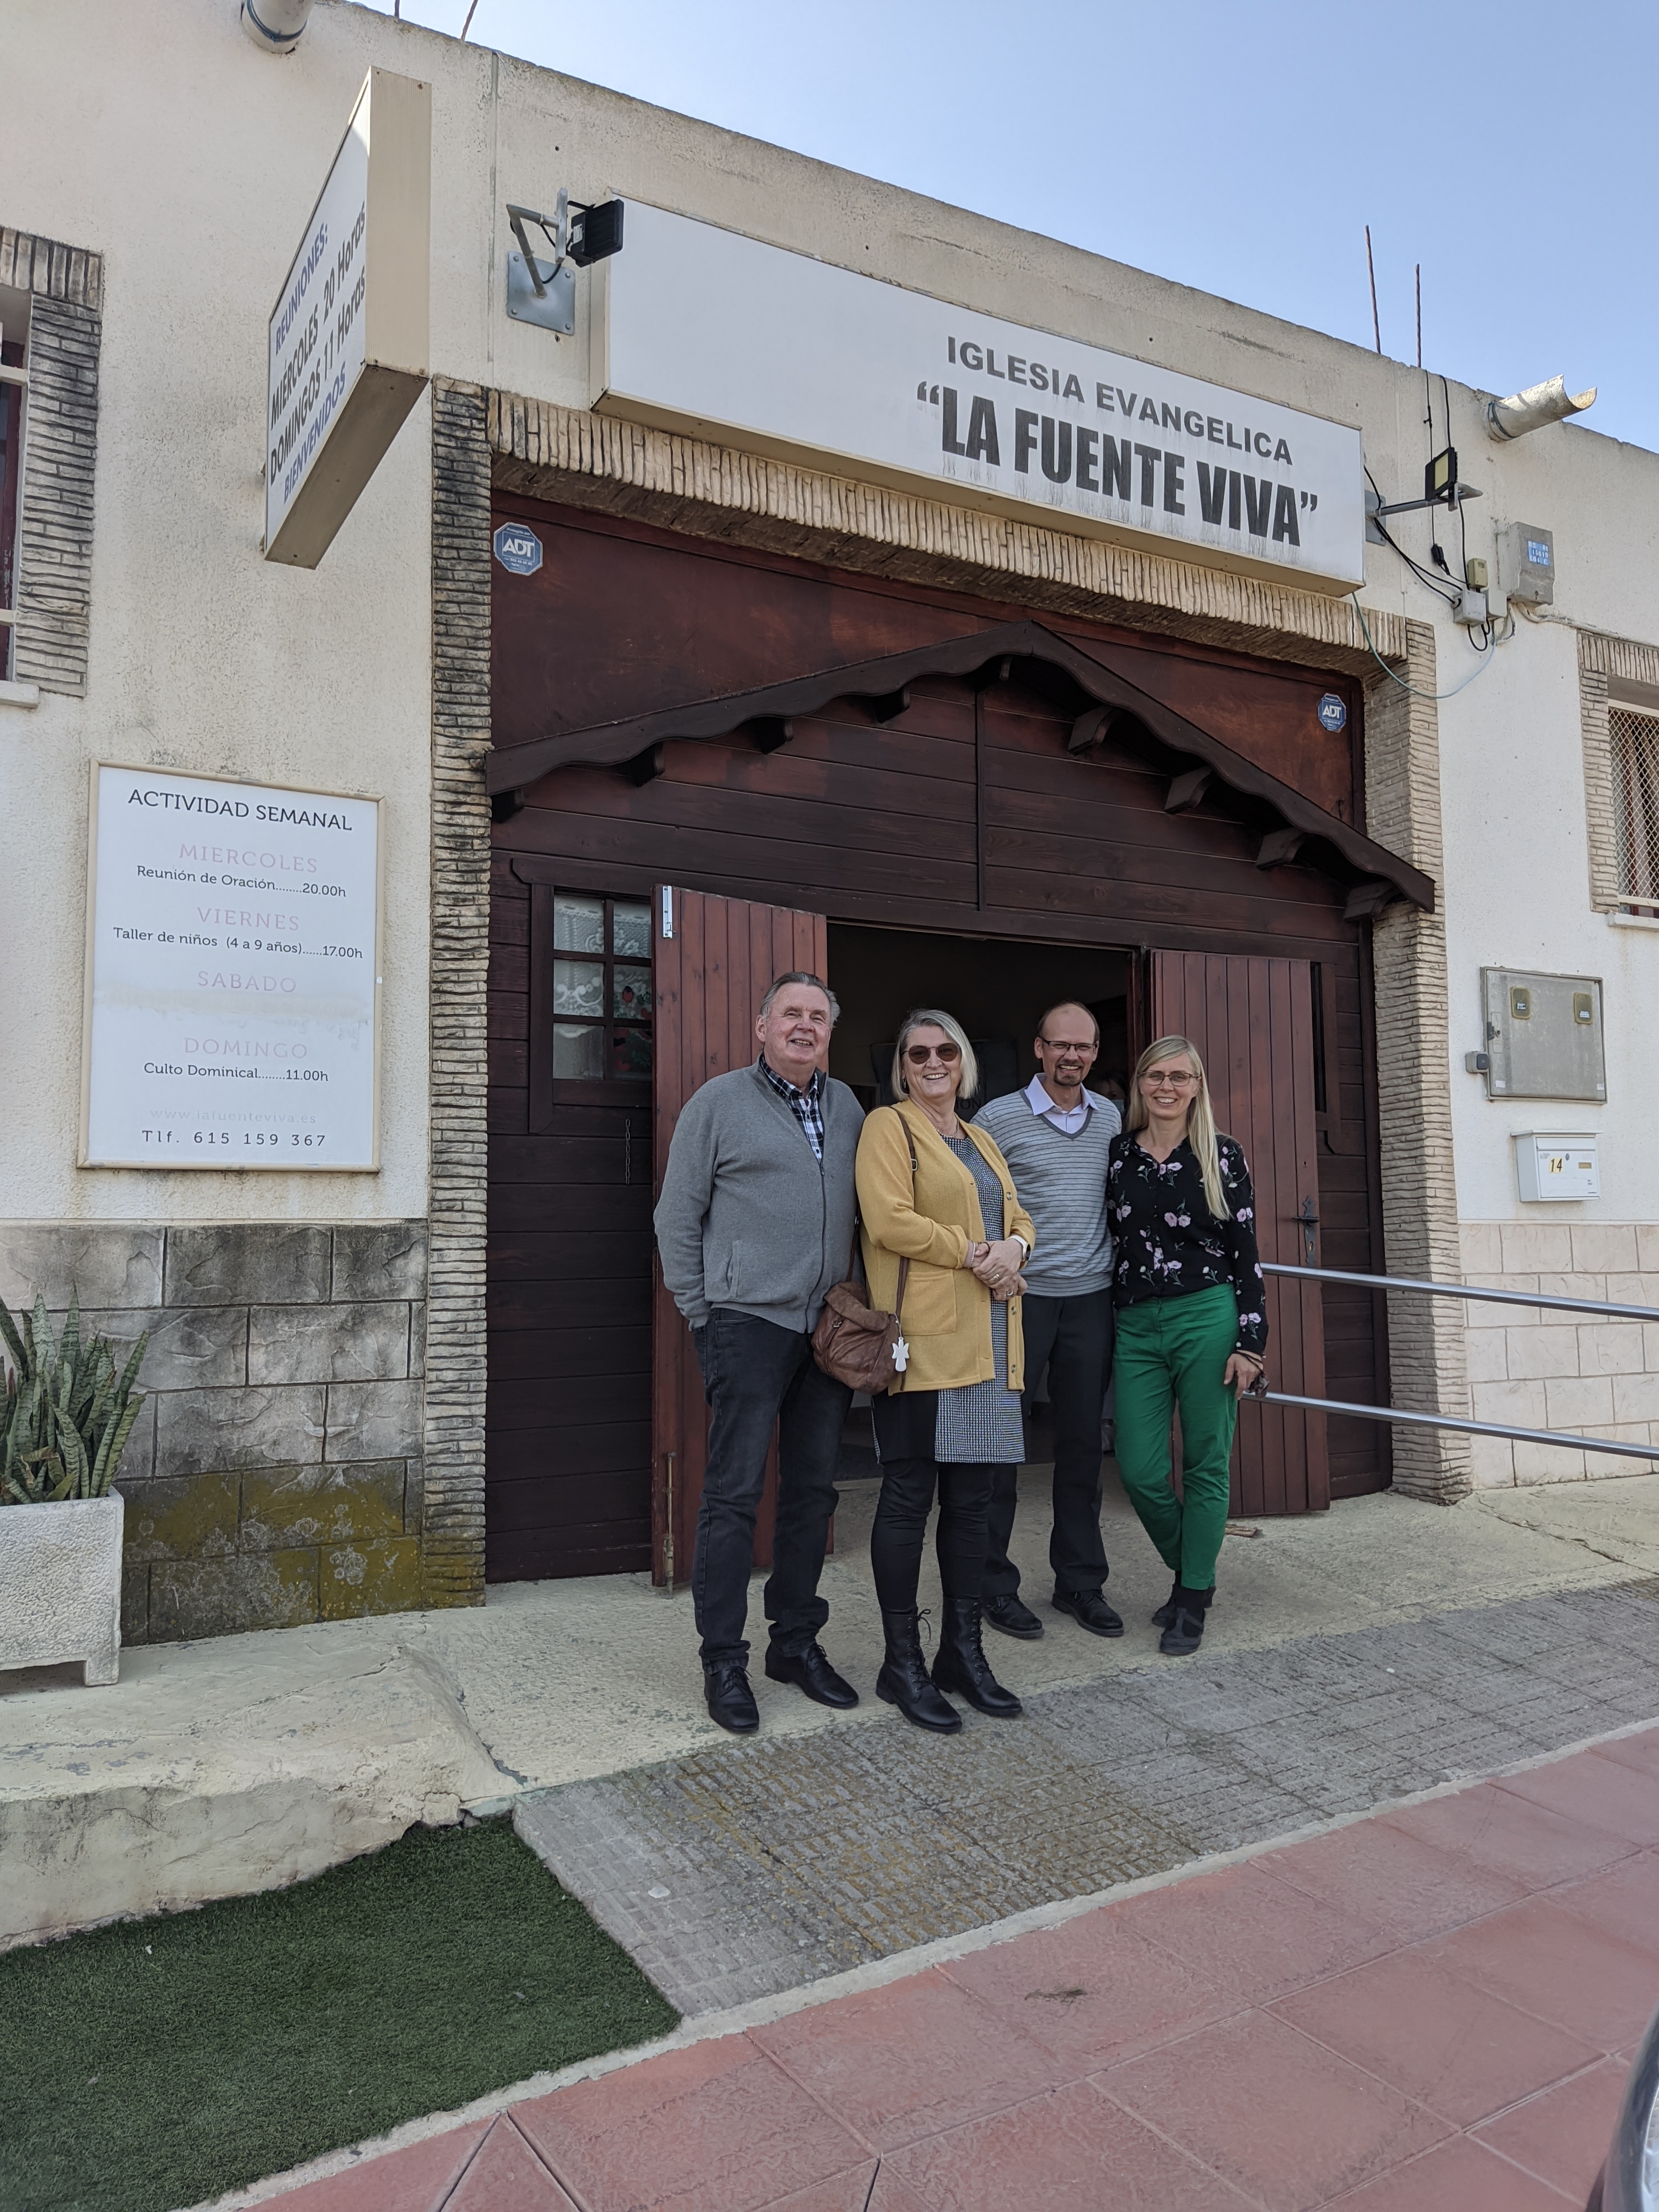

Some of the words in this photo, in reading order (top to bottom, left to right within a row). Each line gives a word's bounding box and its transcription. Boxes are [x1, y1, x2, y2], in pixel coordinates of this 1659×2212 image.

[276, 223, 328, 357] REUNIONES:
[270, 302, 319, 430] MIÉRCOLES
[323, 267, 335, 325] 20
[337, 201, 365, 293] Horas
[270, 357, 321, 487] DOMINGOS
[324, 330, 333, 382] 11
[337, 265, 365, 354] Horas
[947, 336, 1086, 403] IGLESIA
[1095, 382, 1293, 466] EVANGELICA
[284, 361, 346, 504] BIENVENIDOS
[1014, 408, 1186, 517] FUENTE
[502, 538, 535, 558] ADT
[1322, 705, 1342, 719] ADT
[128, 789, 250, 818] ACTIVIDAD
[255, 805, 353, 831] SEMANAL
[179, 843, 318, 873] MIERCOLES
[137, 865, 196, 882] Reunión
[200, 873, 217, 884] de
[197, 906, 300, 931] VIERNES
[113, 927, 153, 941] Taller
[157, 931, 174, 943] de
[179, 933, 218, 947] niños
[226, 937, 239, 949] (4
[243, 941, 250, 950] a
[254, 939, 262, 951] 9
[197, 971, 297, 993] SABADO
[183, 1037, 308, 1059] DOMINGO
[144, 1062, 183, 1076] Culto
[142, 1130, 180, 1144] Tlf.
[194, 1131, 230, 1145] 615
[243, 1132, 279, 1146] 159
[291, 1134, 326, 1147] 367
[1551, 1157, 1563, 1173] 14
